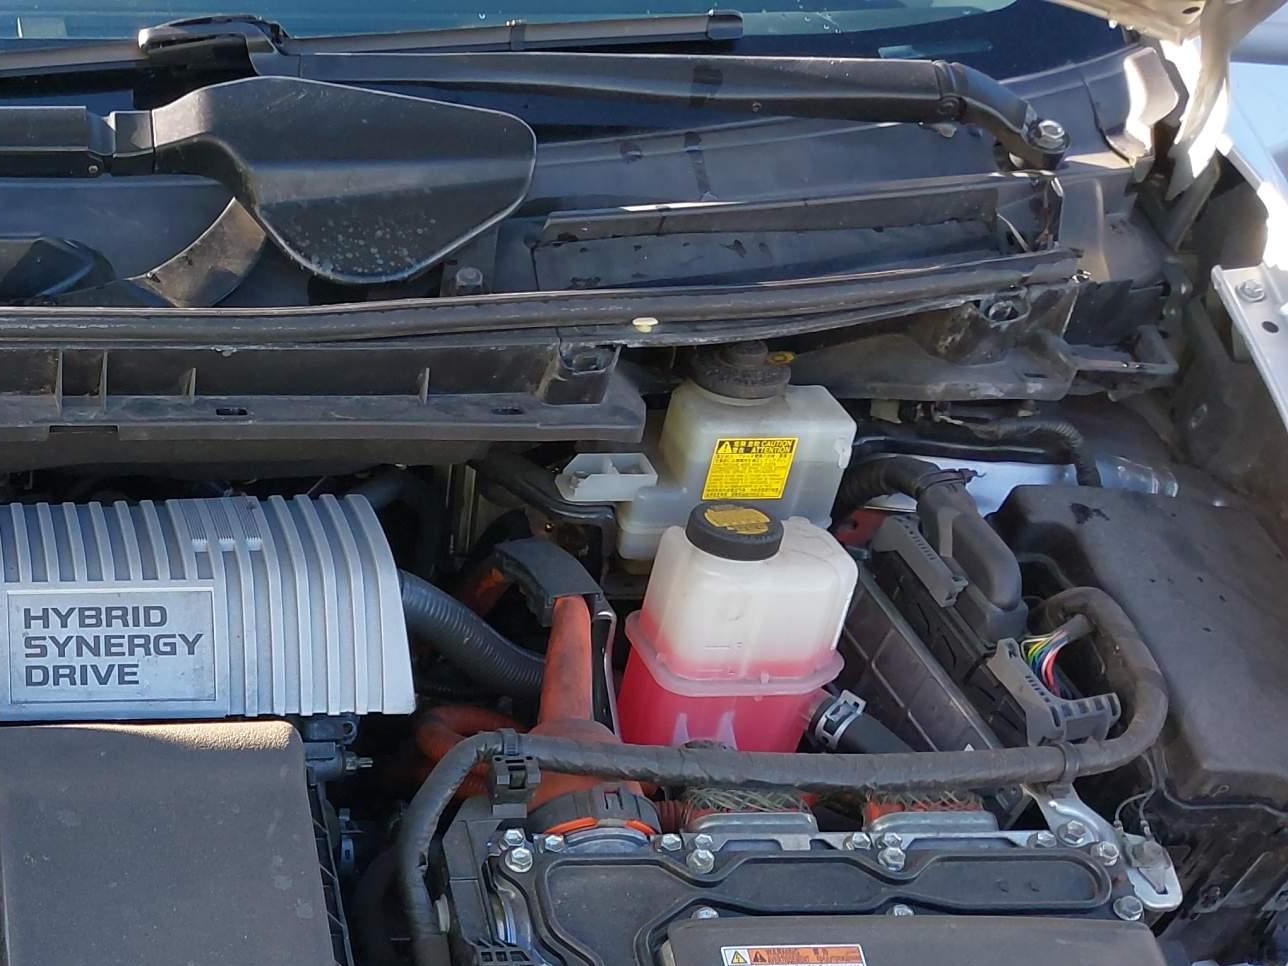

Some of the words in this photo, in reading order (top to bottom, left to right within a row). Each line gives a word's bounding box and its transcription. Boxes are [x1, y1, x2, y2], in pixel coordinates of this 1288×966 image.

[24, 605, 168, 629] HYBRID
[24, 633, 204, 658] SYNERGY
[25, 664, 140, 687] DRIVE
